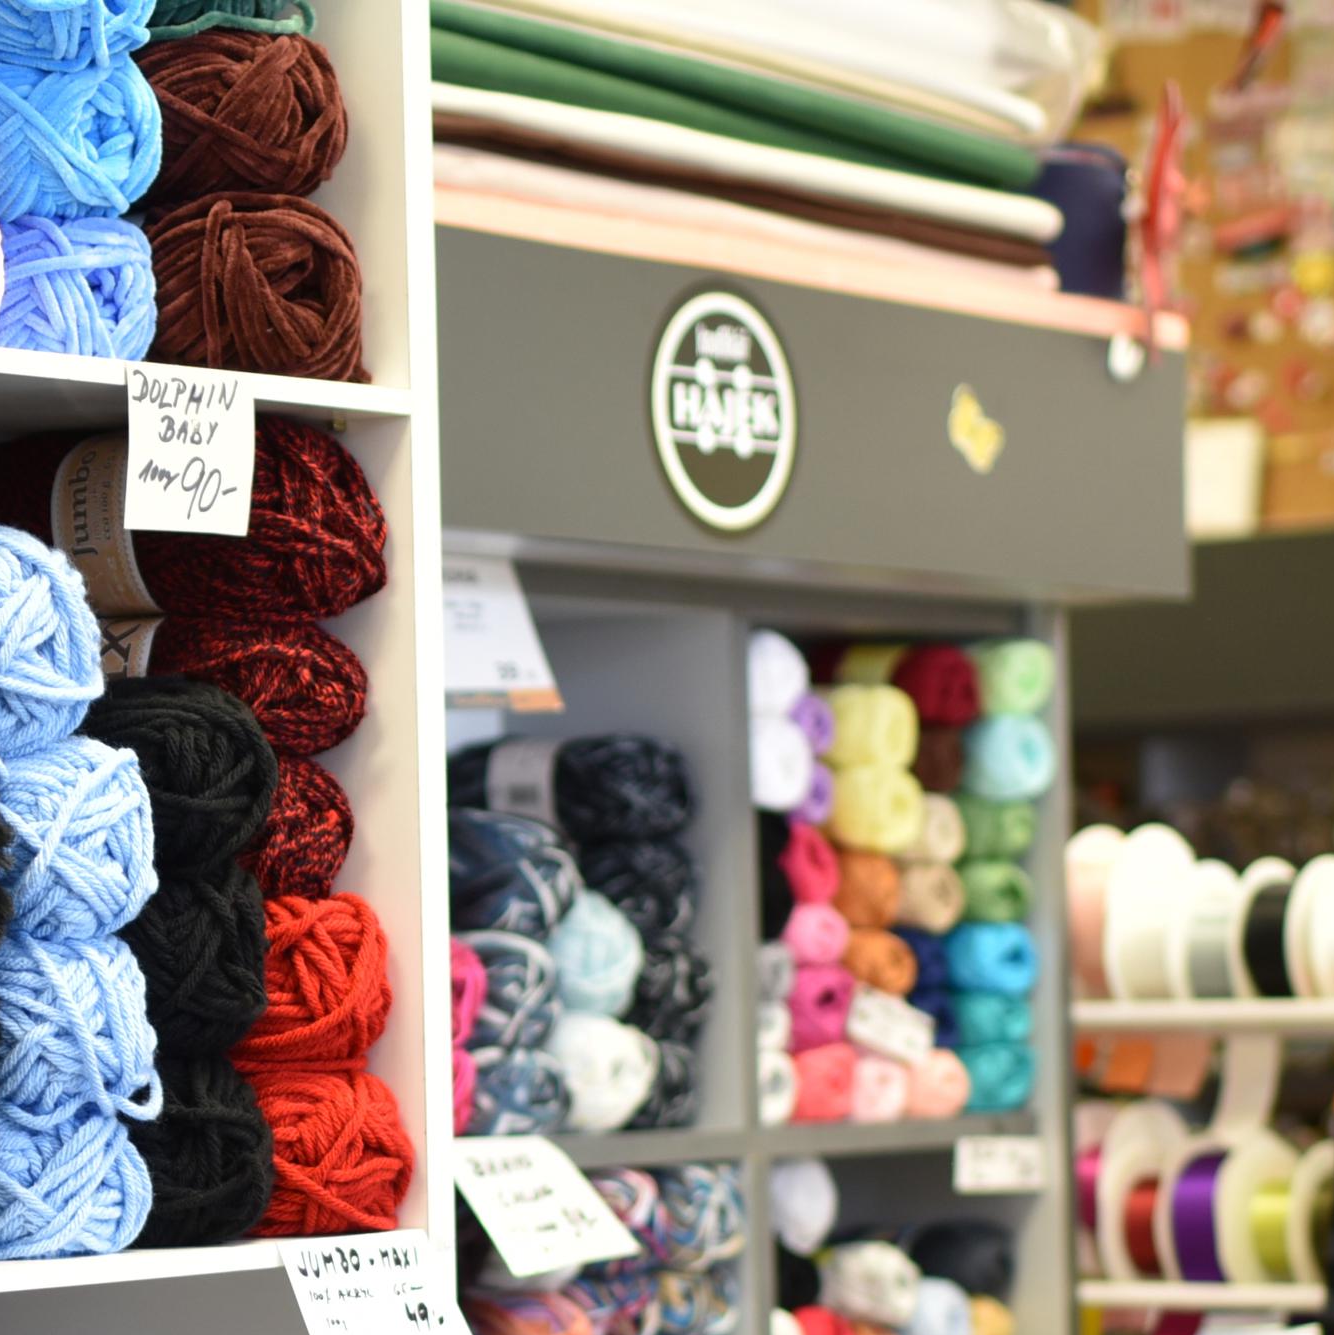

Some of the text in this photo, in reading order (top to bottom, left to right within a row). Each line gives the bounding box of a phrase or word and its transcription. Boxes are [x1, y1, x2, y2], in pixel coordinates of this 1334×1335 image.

[132, 368, 239, 414] DOLPHIN
[157, 415, 219, 447] BABY
[68, 451, 99, 557] Jumbo
[379, 1246, 419, 1271] MAXI
